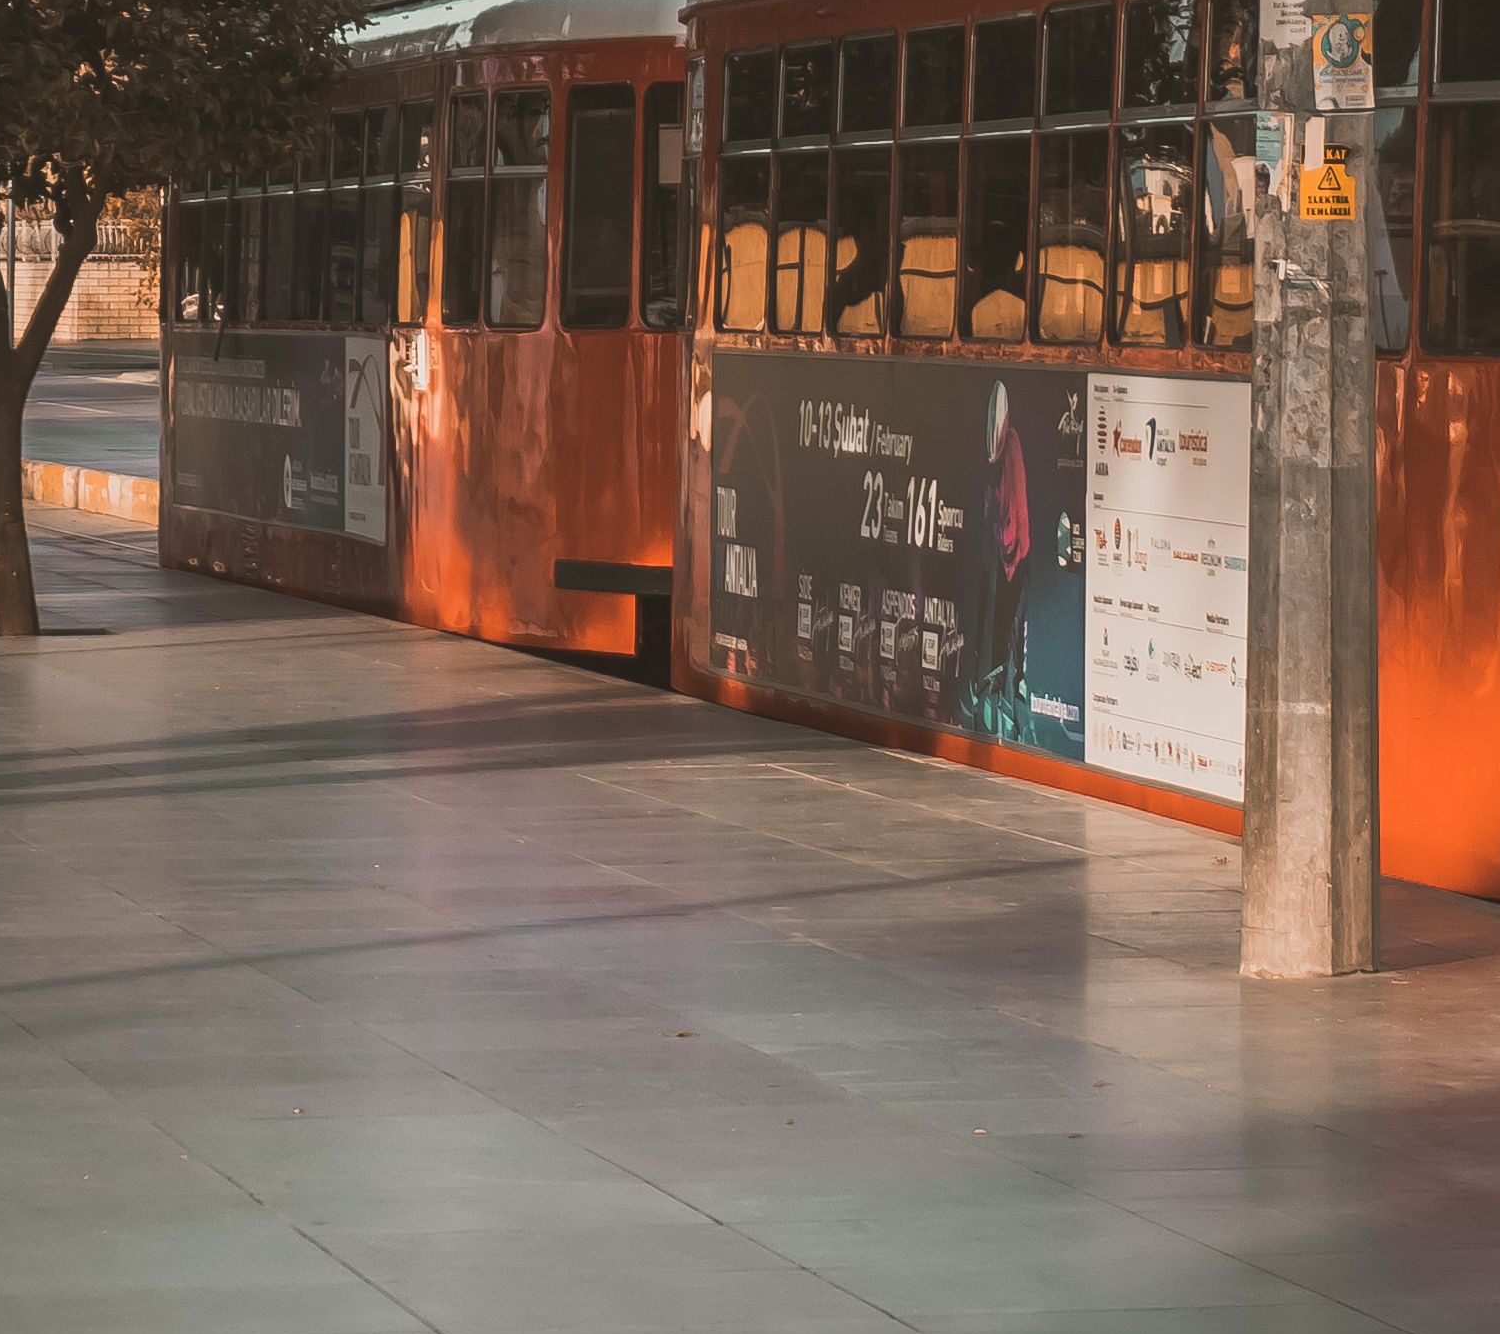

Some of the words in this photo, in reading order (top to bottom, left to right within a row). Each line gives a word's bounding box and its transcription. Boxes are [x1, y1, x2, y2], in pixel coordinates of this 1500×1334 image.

[800, 399, 832, 450] 10-13
[833, 402, 869, 459] Şubat
[861, 470, 884, 540] 23
[907, 476, 938, 548] 161
